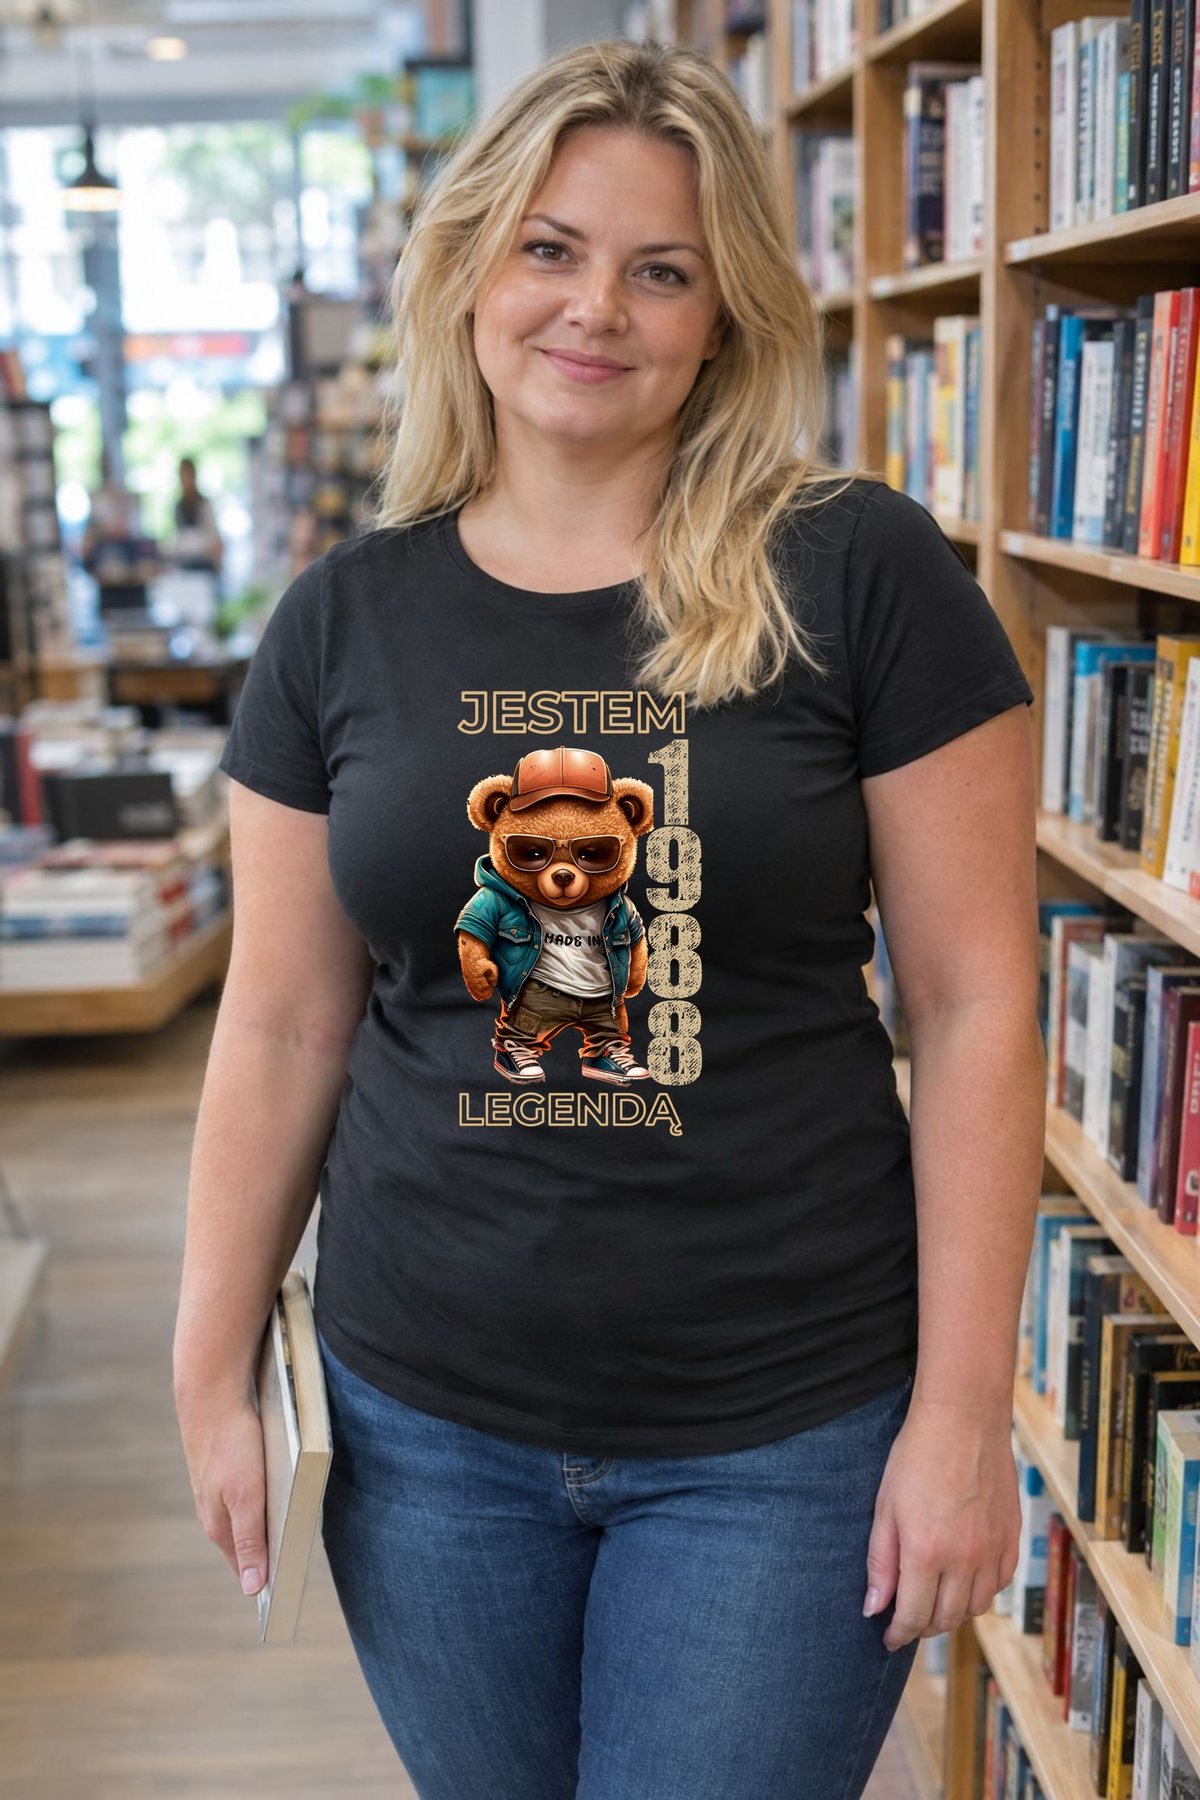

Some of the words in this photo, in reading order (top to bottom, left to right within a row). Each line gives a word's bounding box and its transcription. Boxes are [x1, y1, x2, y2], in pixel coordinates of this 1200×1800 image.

[457, 690, 686, 735] JESTEM
[645, 738, 703, 1087] 1988
[458, 1092, 683, 1137] LEGENDĄ
